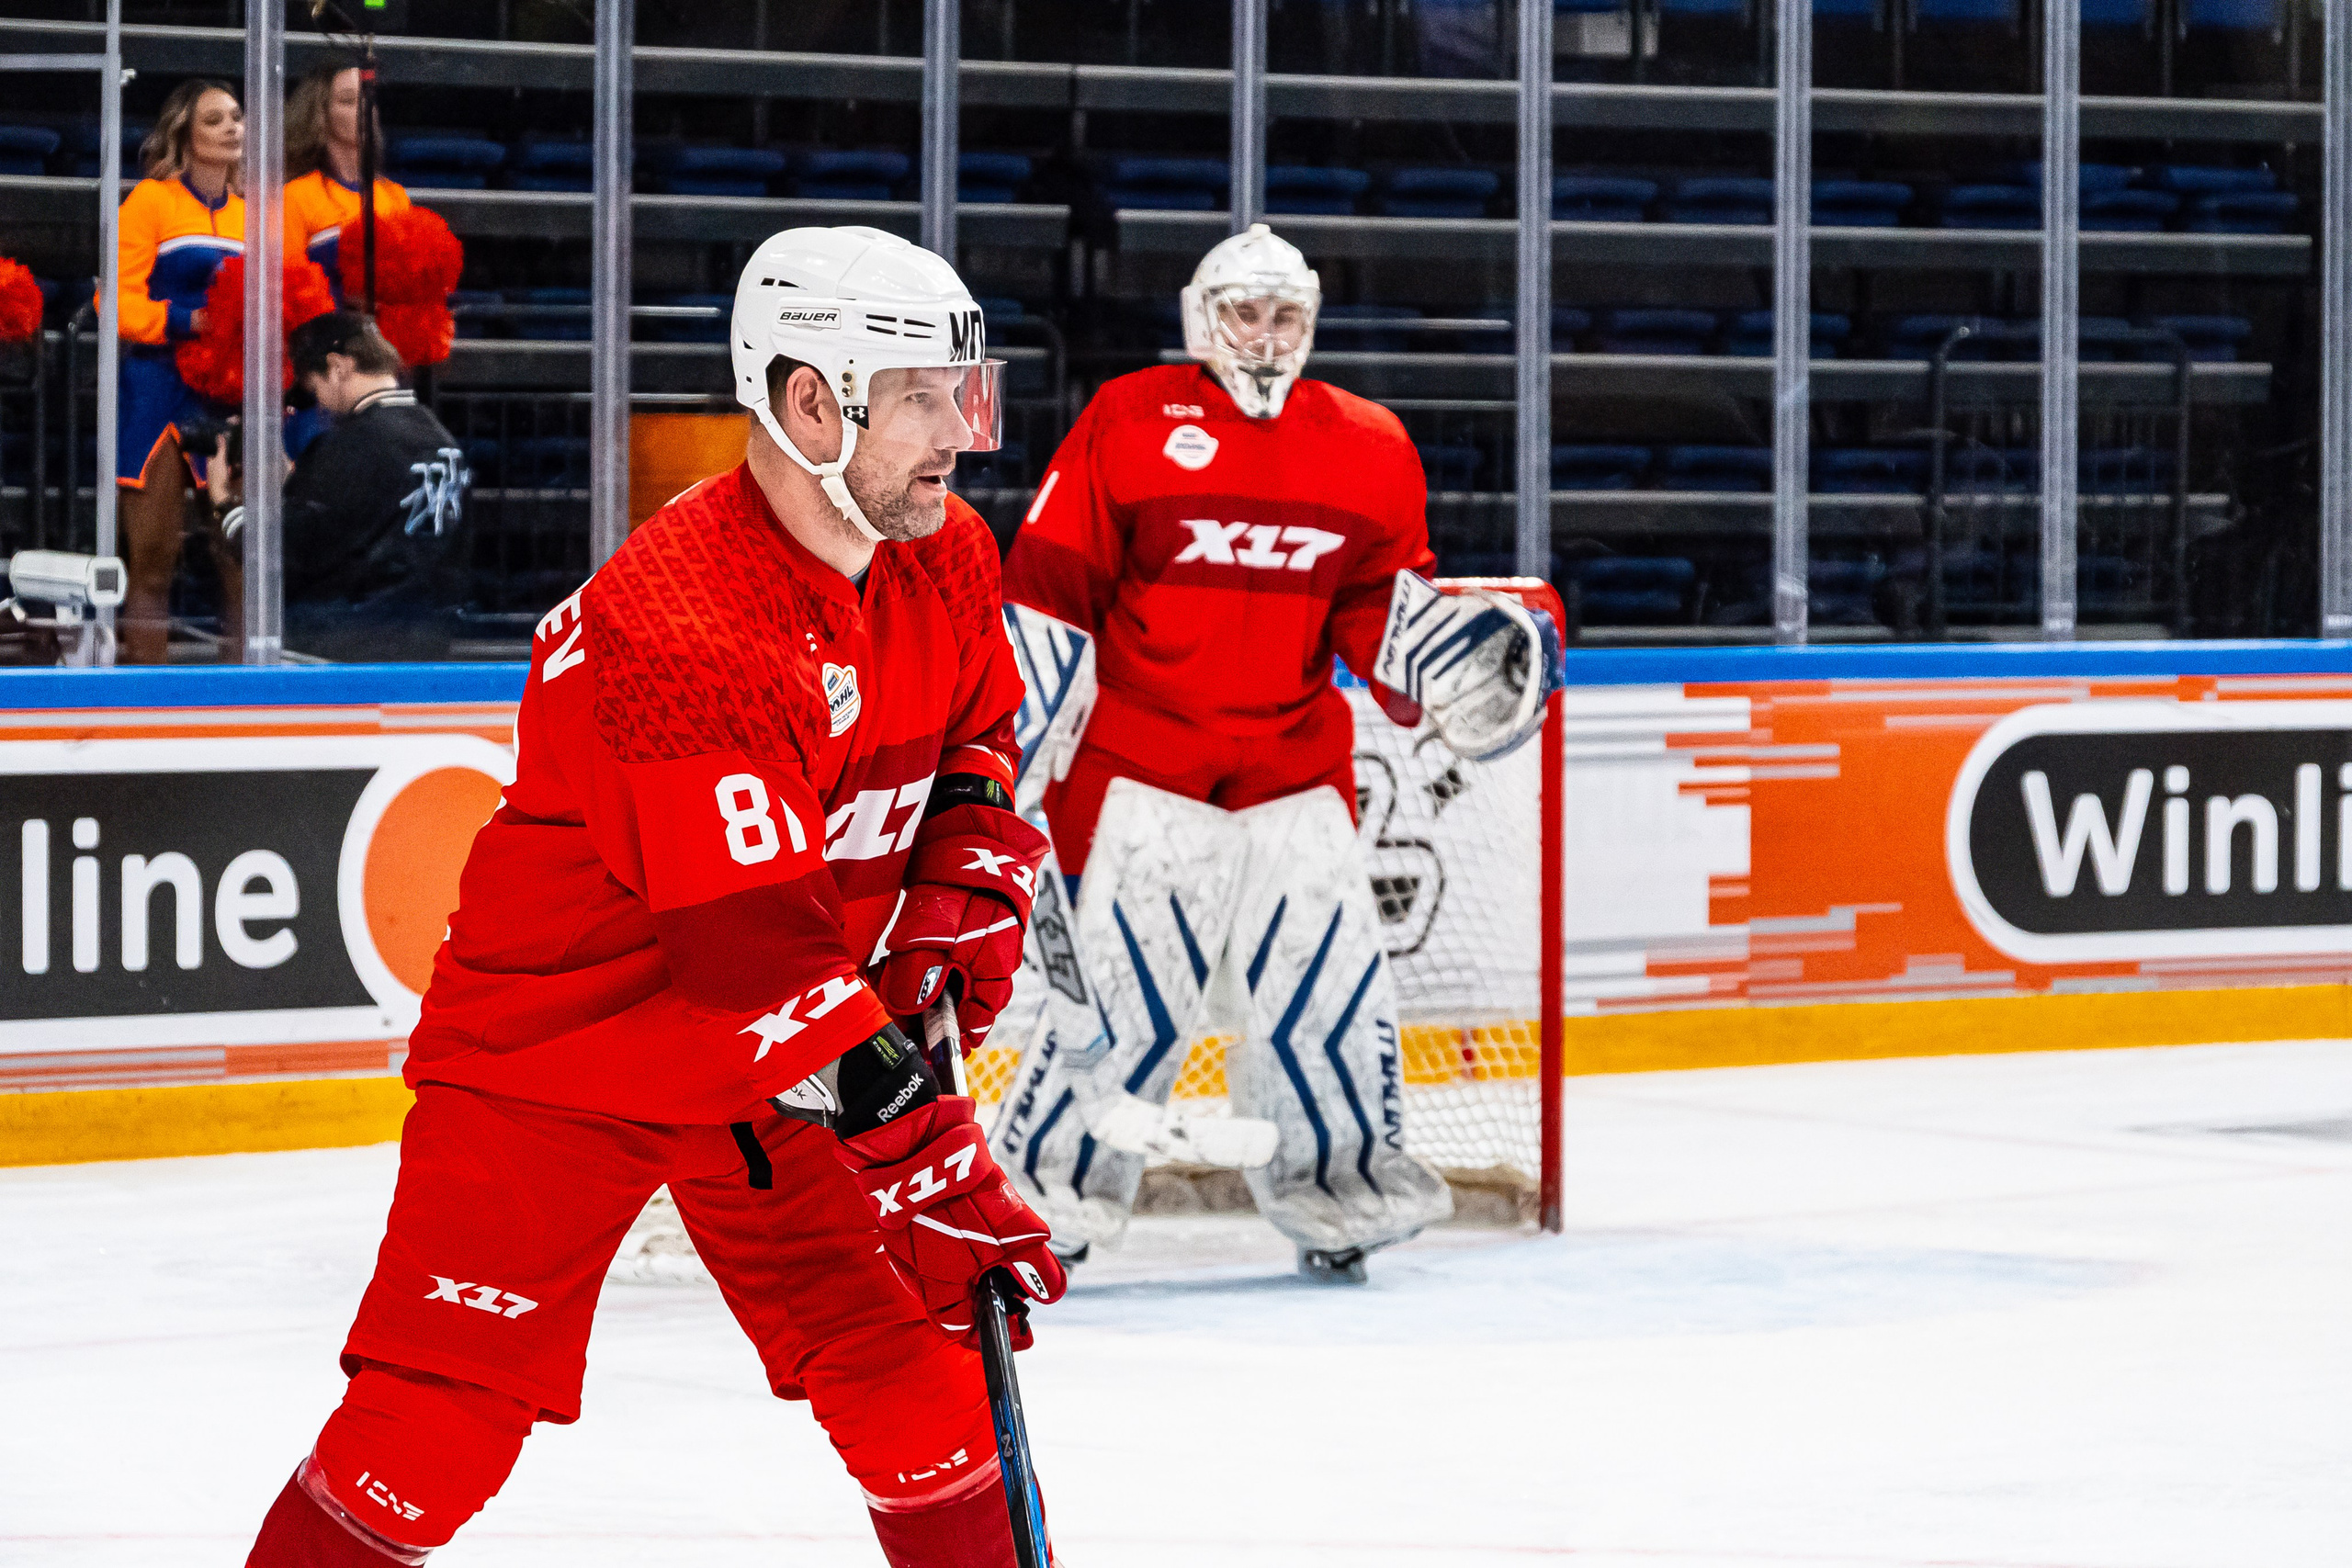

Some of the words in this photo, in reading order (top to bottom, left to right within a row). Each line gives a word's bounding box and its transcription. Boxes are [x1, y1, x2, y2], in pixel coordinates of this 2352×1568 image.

[779, 310, 838, 322] BAUER
[1174, 519, 1346, 571] X17
[21, 817, 300, 975] line
[961, 847, 1039, 911] X1
[736, 975, 868, 1064] X1
[876, 1072, 924, 1123] Reebok
[869, 1142, 978, 1218] X17
[423, 1274, 539, 1319] X17
